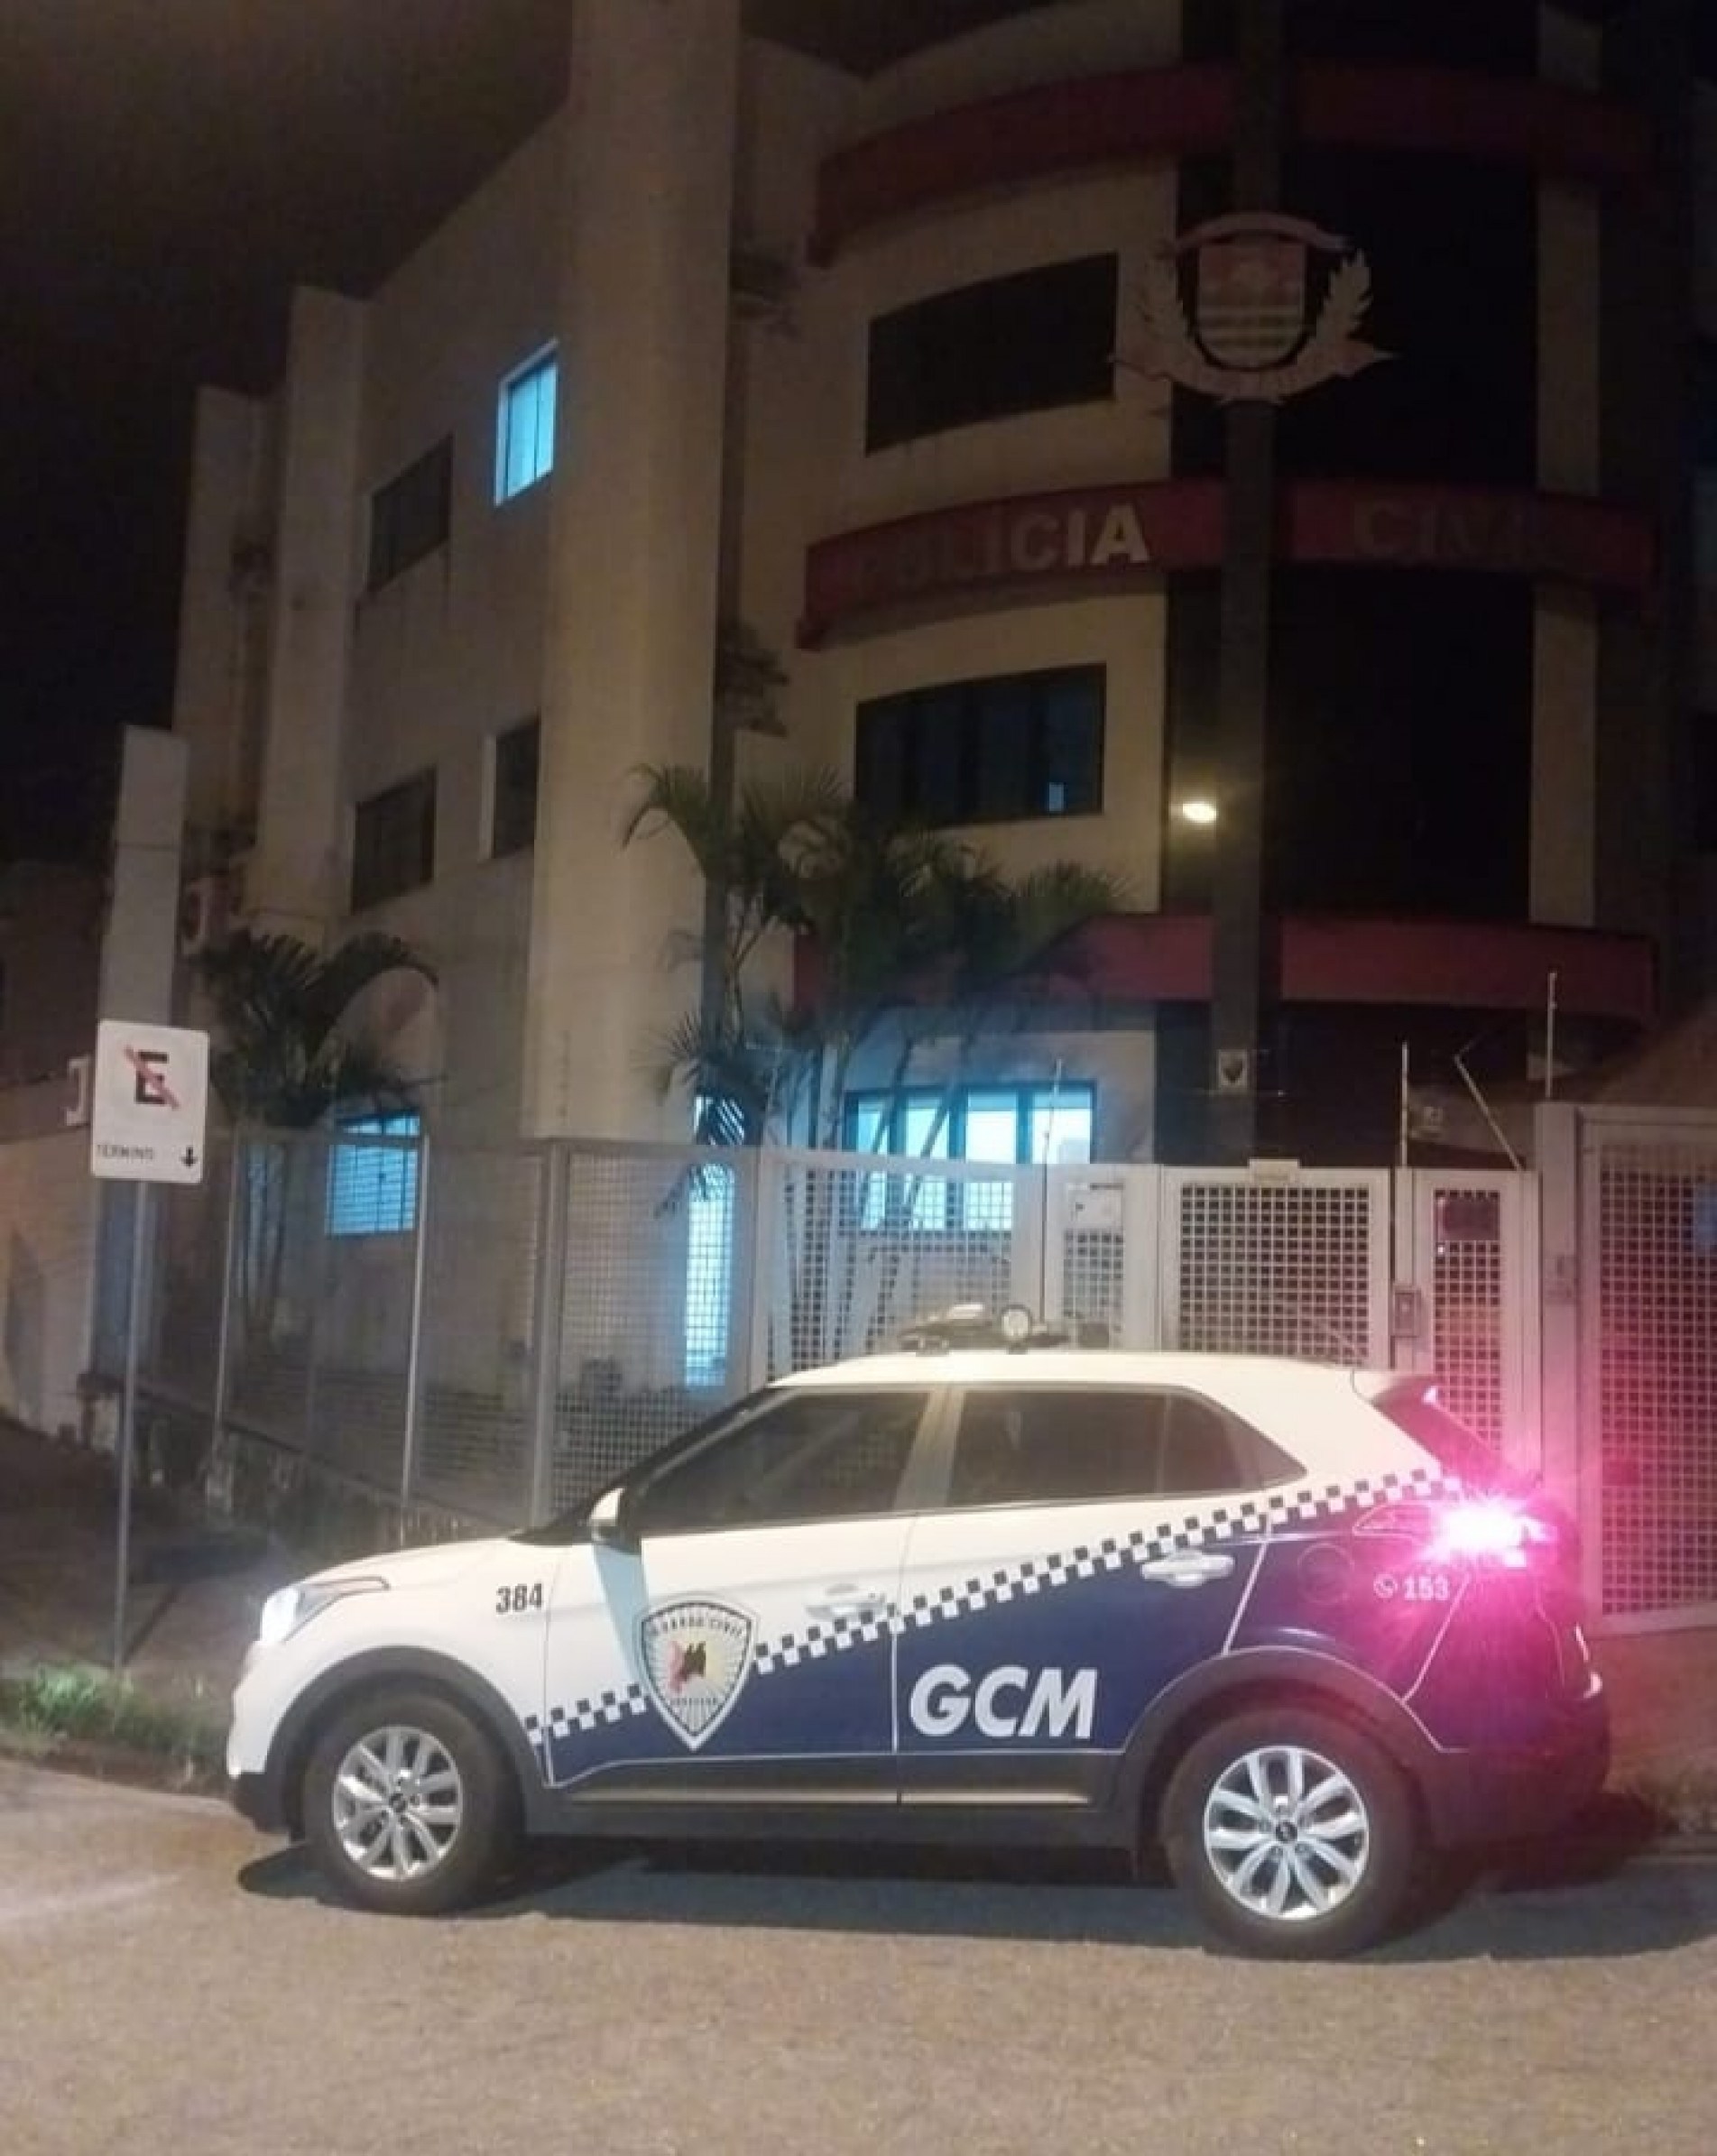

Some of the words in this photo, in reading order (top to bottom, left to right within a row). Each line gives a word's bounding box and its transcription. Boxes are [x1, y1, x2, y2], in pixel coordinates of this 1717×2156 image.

[135, 1050, 171, 1106] E
[496, 1583, 541, 1614] 384
[1404, 1574, 1449, 1600] 153
[909, 1663, 1097, 1738] GCM
